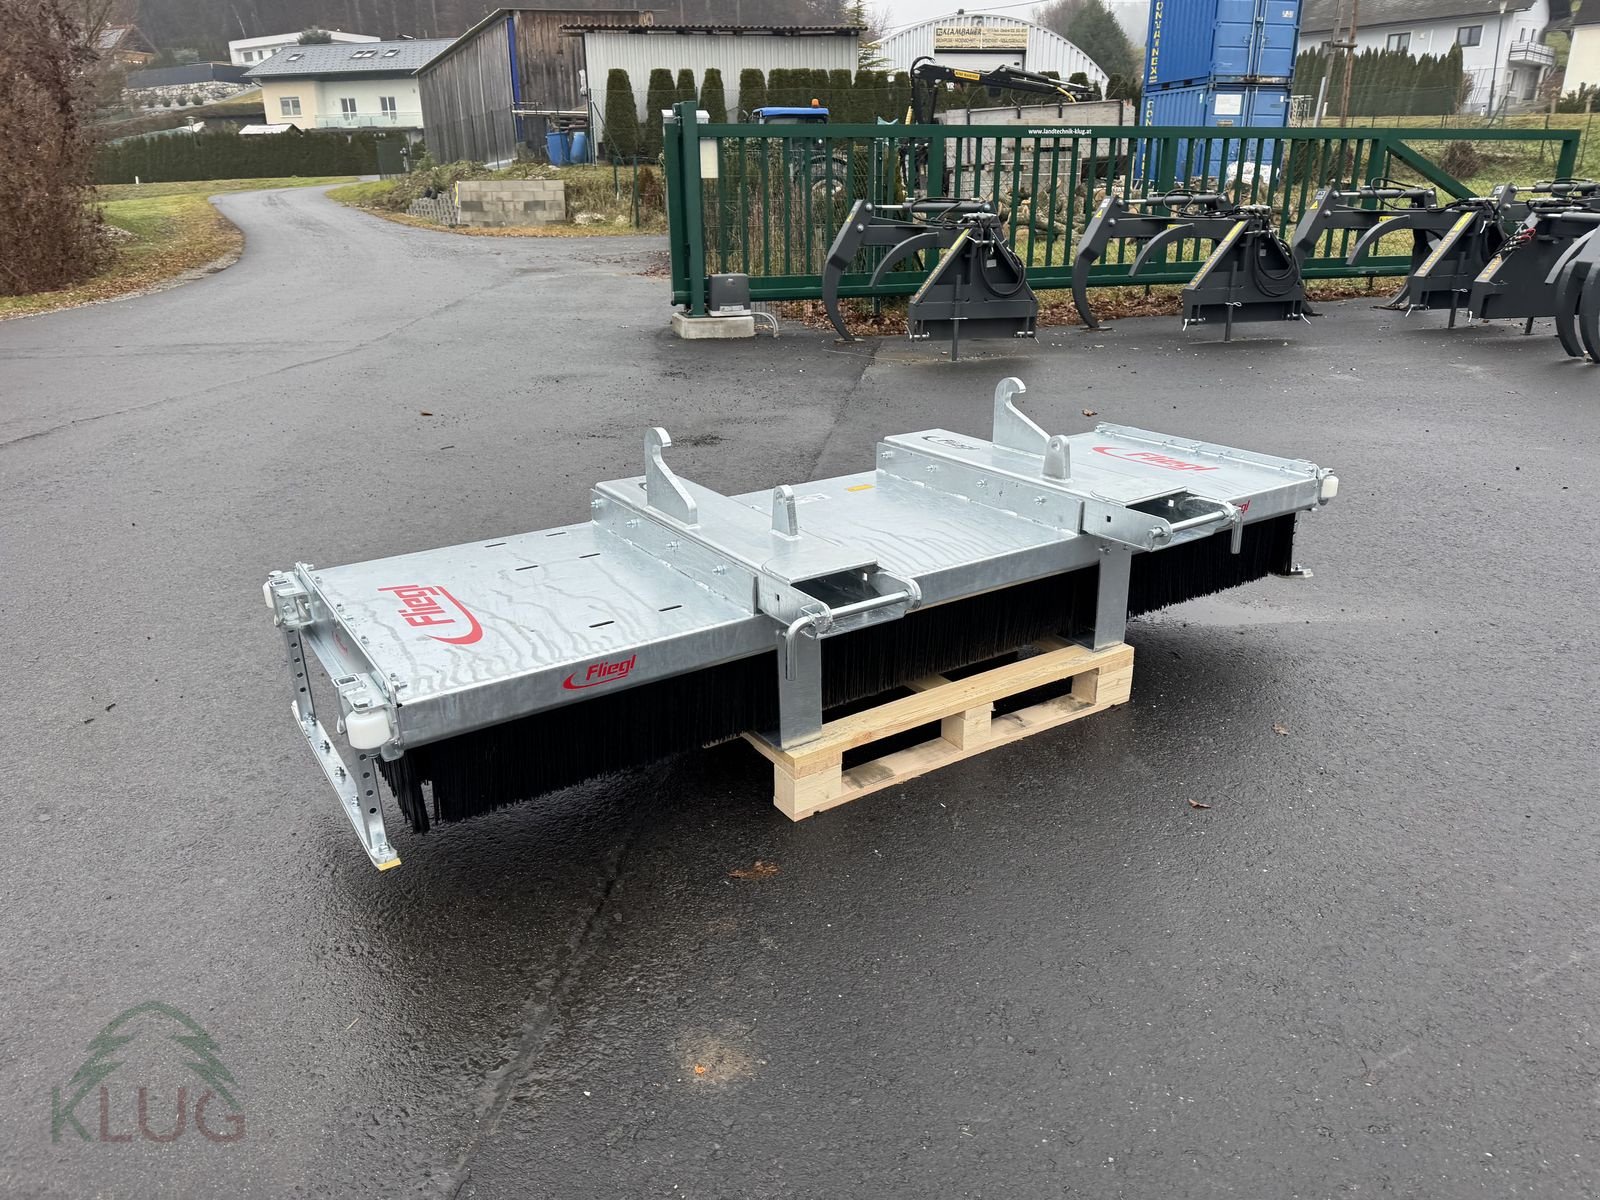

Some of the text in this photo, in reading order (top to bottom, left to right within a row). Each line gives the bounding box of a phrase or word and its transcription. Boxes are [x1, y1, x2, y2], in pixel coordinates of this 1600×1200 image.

[1150, 1, 1164, 75] ONTAINEX
[1028, 127, 1092, 136] www.landtechnik-klug.at
[1124, 452, 1221, 471] Fliegl
[377, 584, 456, 627] Fliegl
[585, 654, 637, 681] Fliegl
